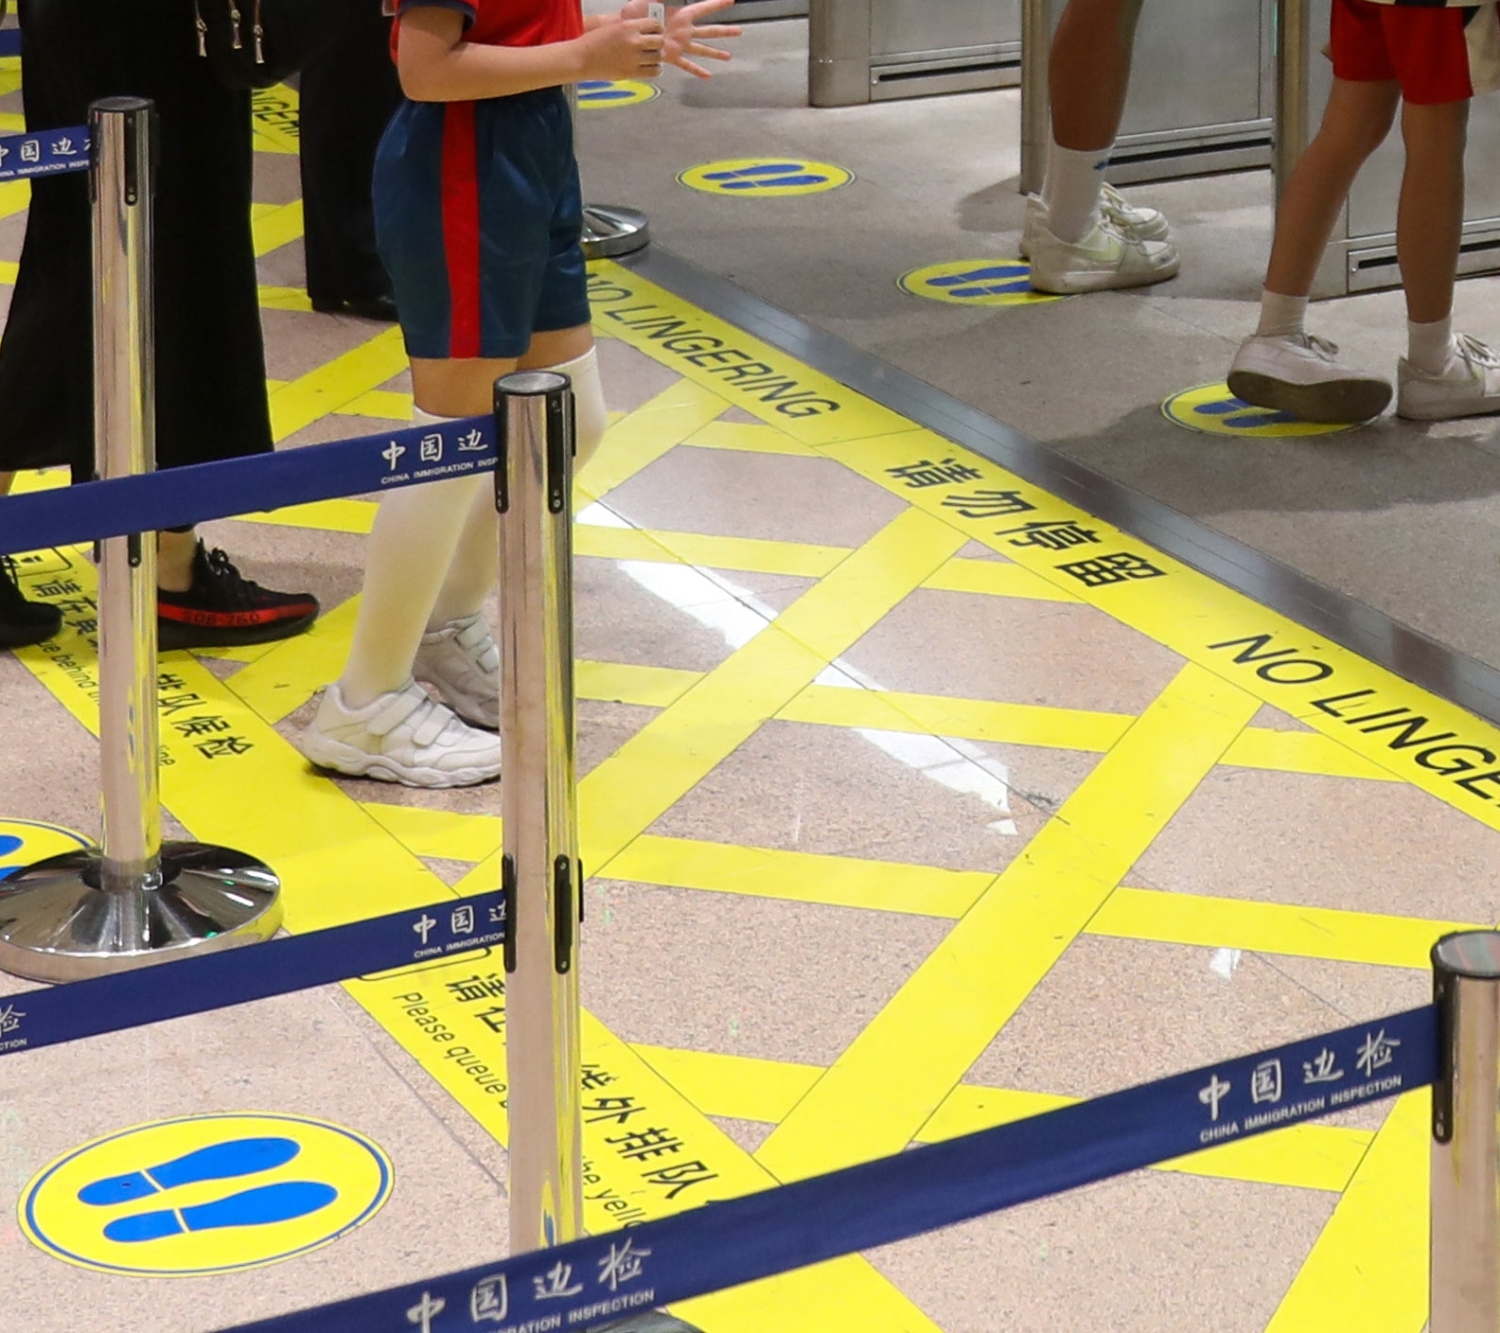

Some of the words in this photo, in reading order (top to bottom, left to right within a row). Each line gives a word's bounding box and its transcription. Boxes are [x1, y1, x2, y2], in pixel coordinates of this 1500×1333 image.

[603, 305, 841, 419] LINGERING
[381, 473, 409, 485] CHINA
[414, 462, 473, 479] IMMIGRATION
[886, 456, 1168, 588] 请勿停留
[1207, 633, 1336, 687] NO
[414, 945, 442, 958] CHINA
[446, 932, 504, 951] IMMIGRATION
[393, 991, 455, 1042] Please
[448, 1046, 507, 1094] queue
[1199, 1029, 1401, 1120] 中国边检
[1200, 1125, 1238, 1142] CHINA
[1244, 1100, 1324, 1131] IMMIGRATION
[1330, 1076, 1402, 1105] INSPECTION
[407, 1238, 651, 1333] 中国边检
[569, 1288, 654, 1324] INSPECTION
